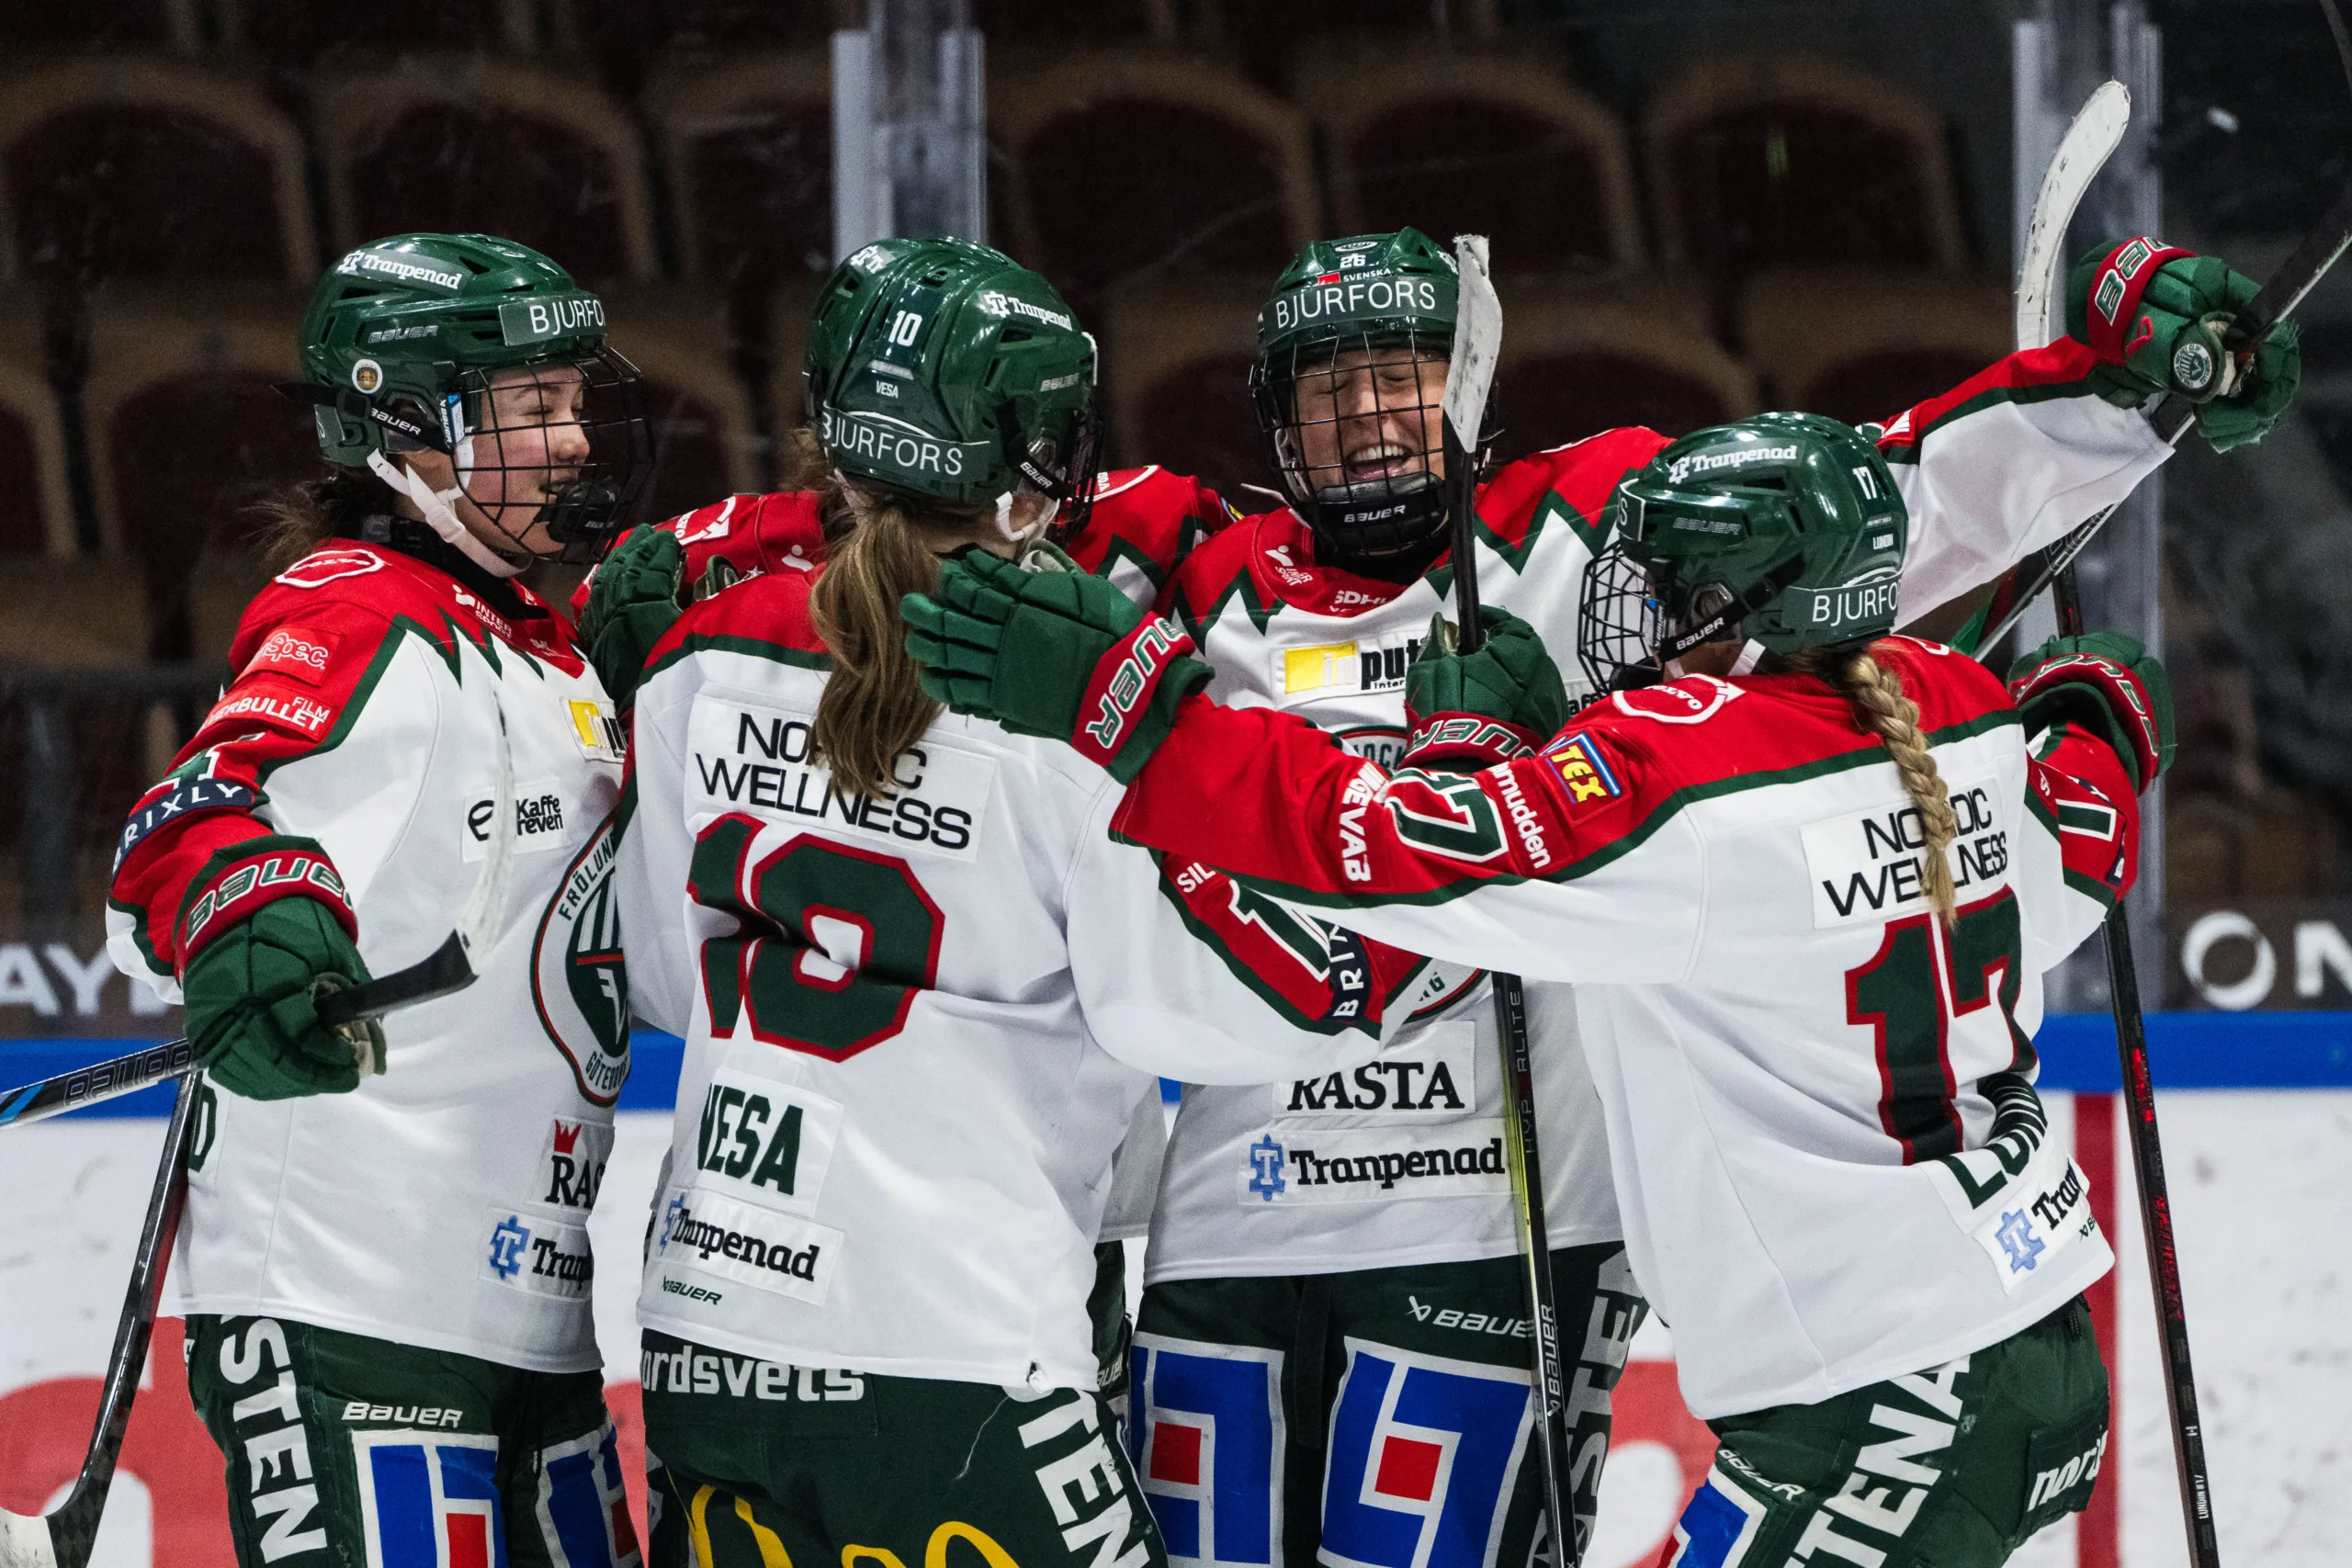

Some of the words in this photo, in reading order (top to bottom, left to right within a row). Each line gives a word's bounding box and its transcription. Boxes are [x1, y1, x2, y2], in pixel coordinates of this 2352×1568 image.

[1340, 254, 1366, 268] 26
[1343, 267, 1392, 282] SVENSKA
[888, 310, 922, 346] 10
[1275, 282, 1436, 329] BJURFORS
[876, 380, 899, 399] VESA
[1852, 467, 1878, 501] 17
[292, 696, 331, 720] FILM
[515, 795, 561, 819] Kaffe
[516, 813, 563, 836] reven
[695, 753, 973, 850] WELLNESS
[1862, 787, 1993, 860] NODIC
[1822, 830, 2008, 917] WELNESS
[186, 857, 356, 949] BAUE
[686, 812, 945, 1064] 10
[1845, 884, 2039, 1167] 17
[697, 1082, 804, 1196] VESA
[1290, 1138, 1506, 1190] Tranpenad
